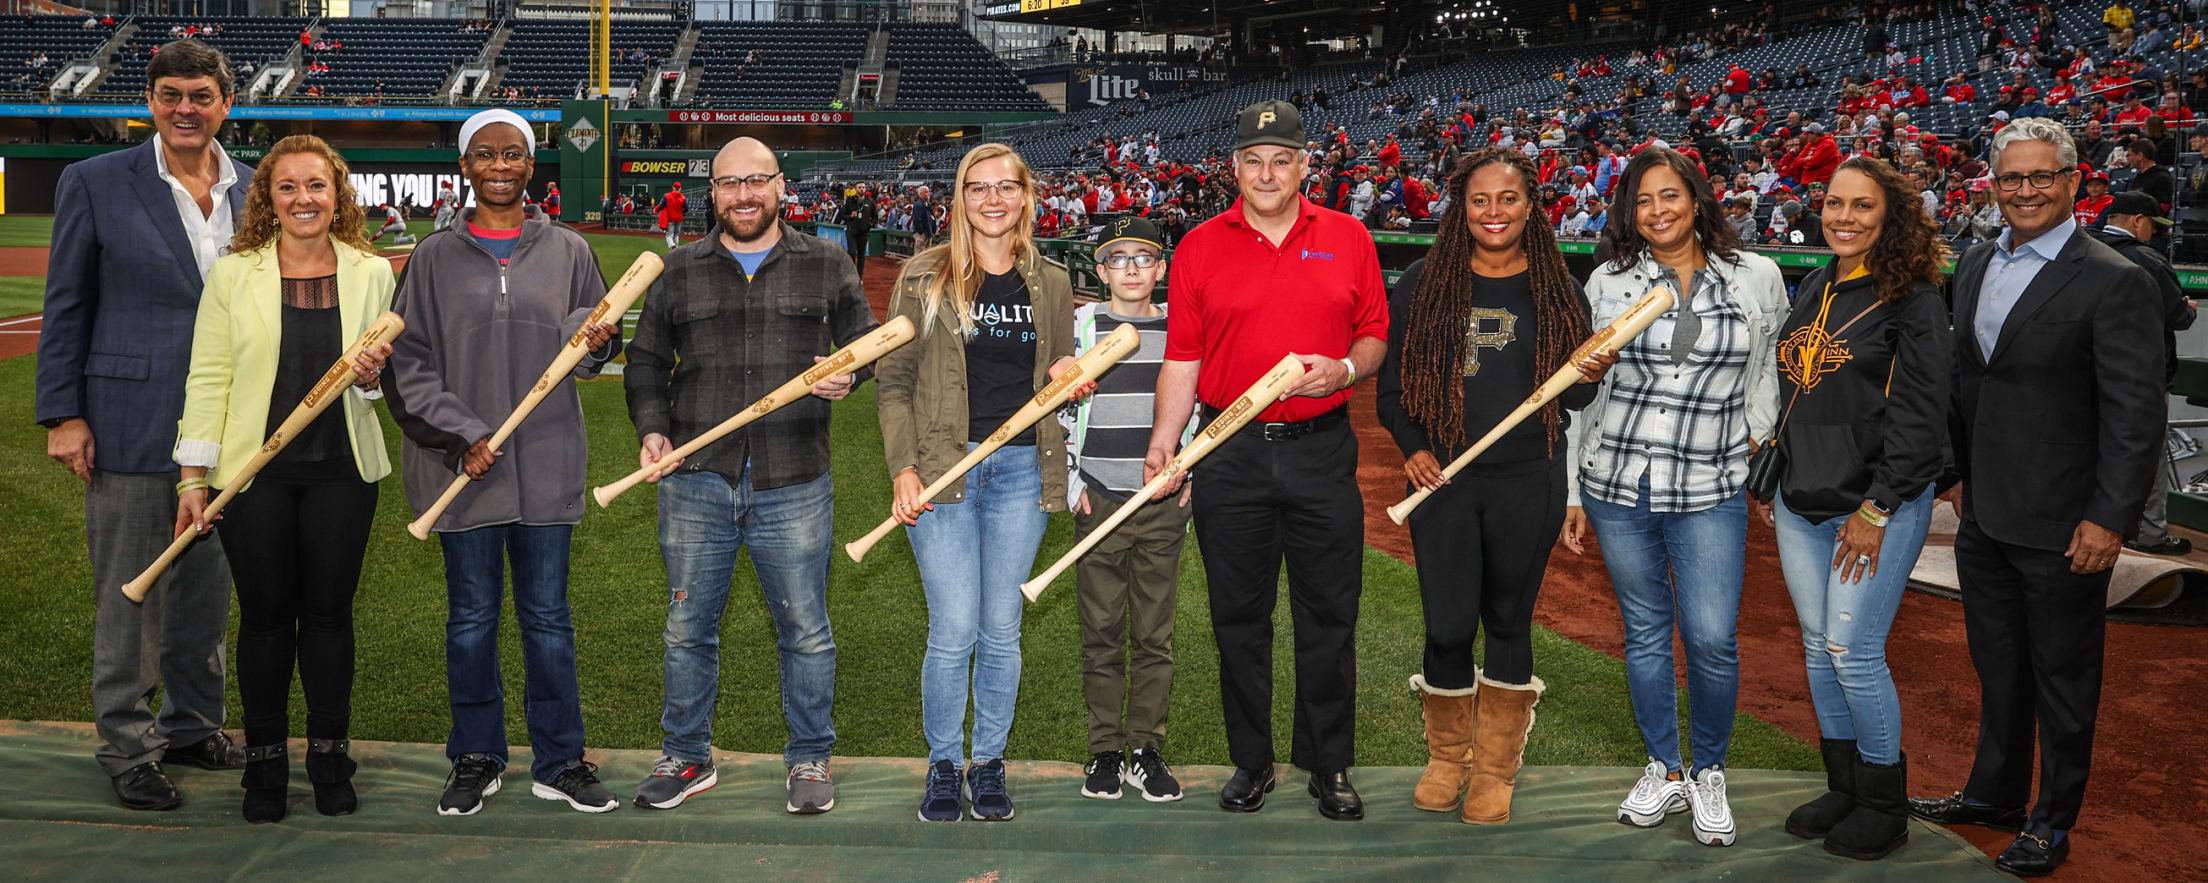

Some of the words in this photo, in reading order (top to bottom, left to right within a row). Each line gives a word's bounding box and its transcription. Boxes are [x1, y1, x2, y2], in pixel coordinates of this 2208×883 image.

[1149, 66, 1183, 81] skull
[1203, 67, 1226, 82] bar
[1088, 75, 1139, 106] Lite
[716, 112, 737, 121] Most
[739, 112, 780, 122] delicious
[782, 114, 806, 122] seats
[564, 127, 601, 141] CLEMENTE
[579, 138, 587, 147] 21
[241, 150, 261, 158] PARK
[631, 161, 686, 173] BOWSER
[391, 174, 434, 208] YOU
[585, 212, 601, 221] 320
[957, 300, 1034, 325] UALIT
[989, 326, 1012, 338] for
[1021, 331, 1037, 342] go
[1463, 307, 1519, 377] P
[1827, 347, 1850, 356] INN
